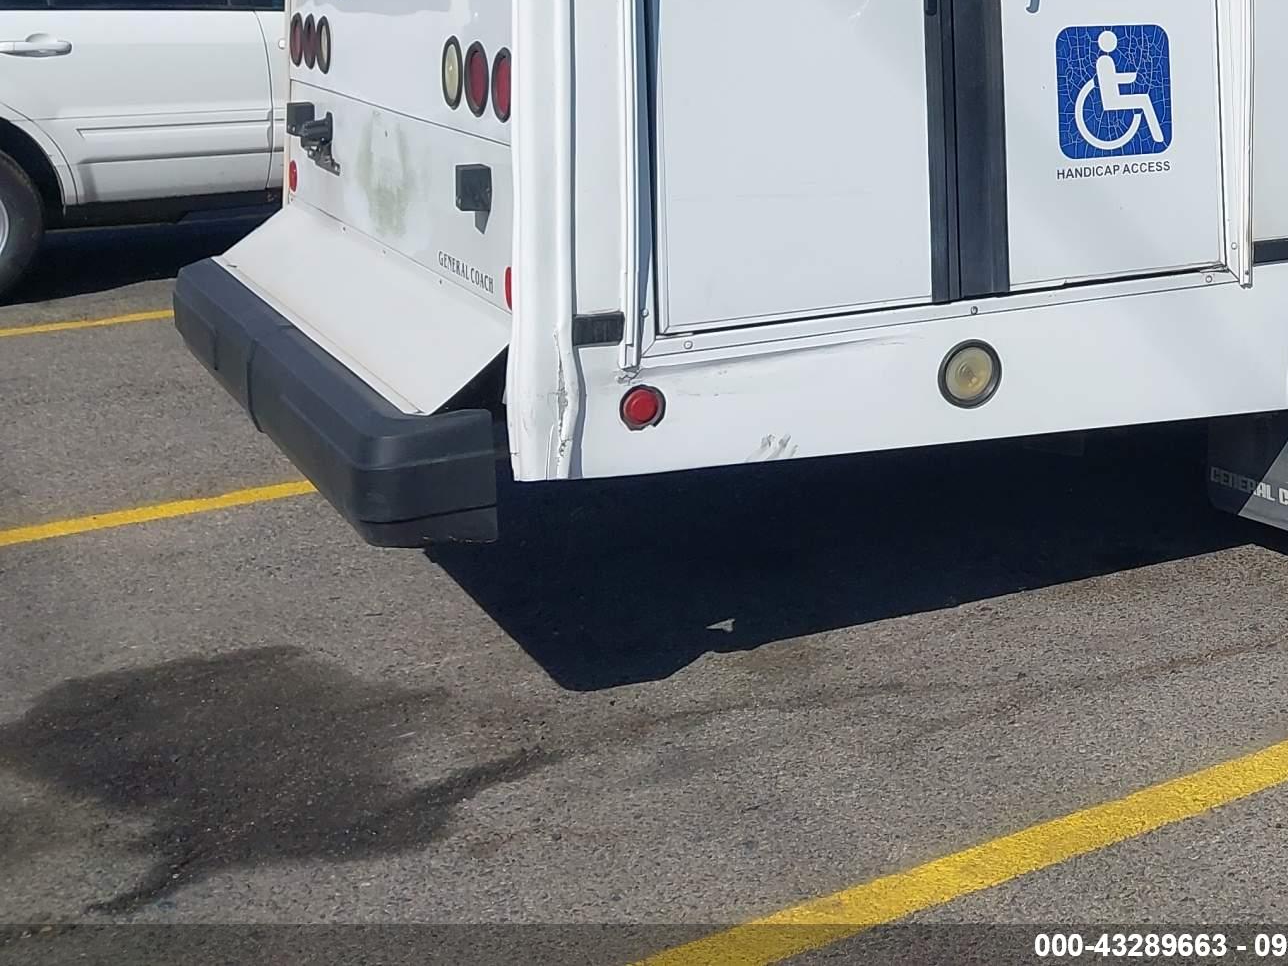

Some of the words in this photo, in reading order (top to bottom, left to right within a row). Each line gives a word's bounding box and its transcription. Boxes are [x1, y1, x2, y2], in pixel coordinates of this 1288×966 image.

[1057, 165, 1120, 180] HANDICAP
[1122, 161, 1171, 175] ACCESS
[438, 251, 470, 281] GENERAL
[470, 267, 494, 294] COACH
